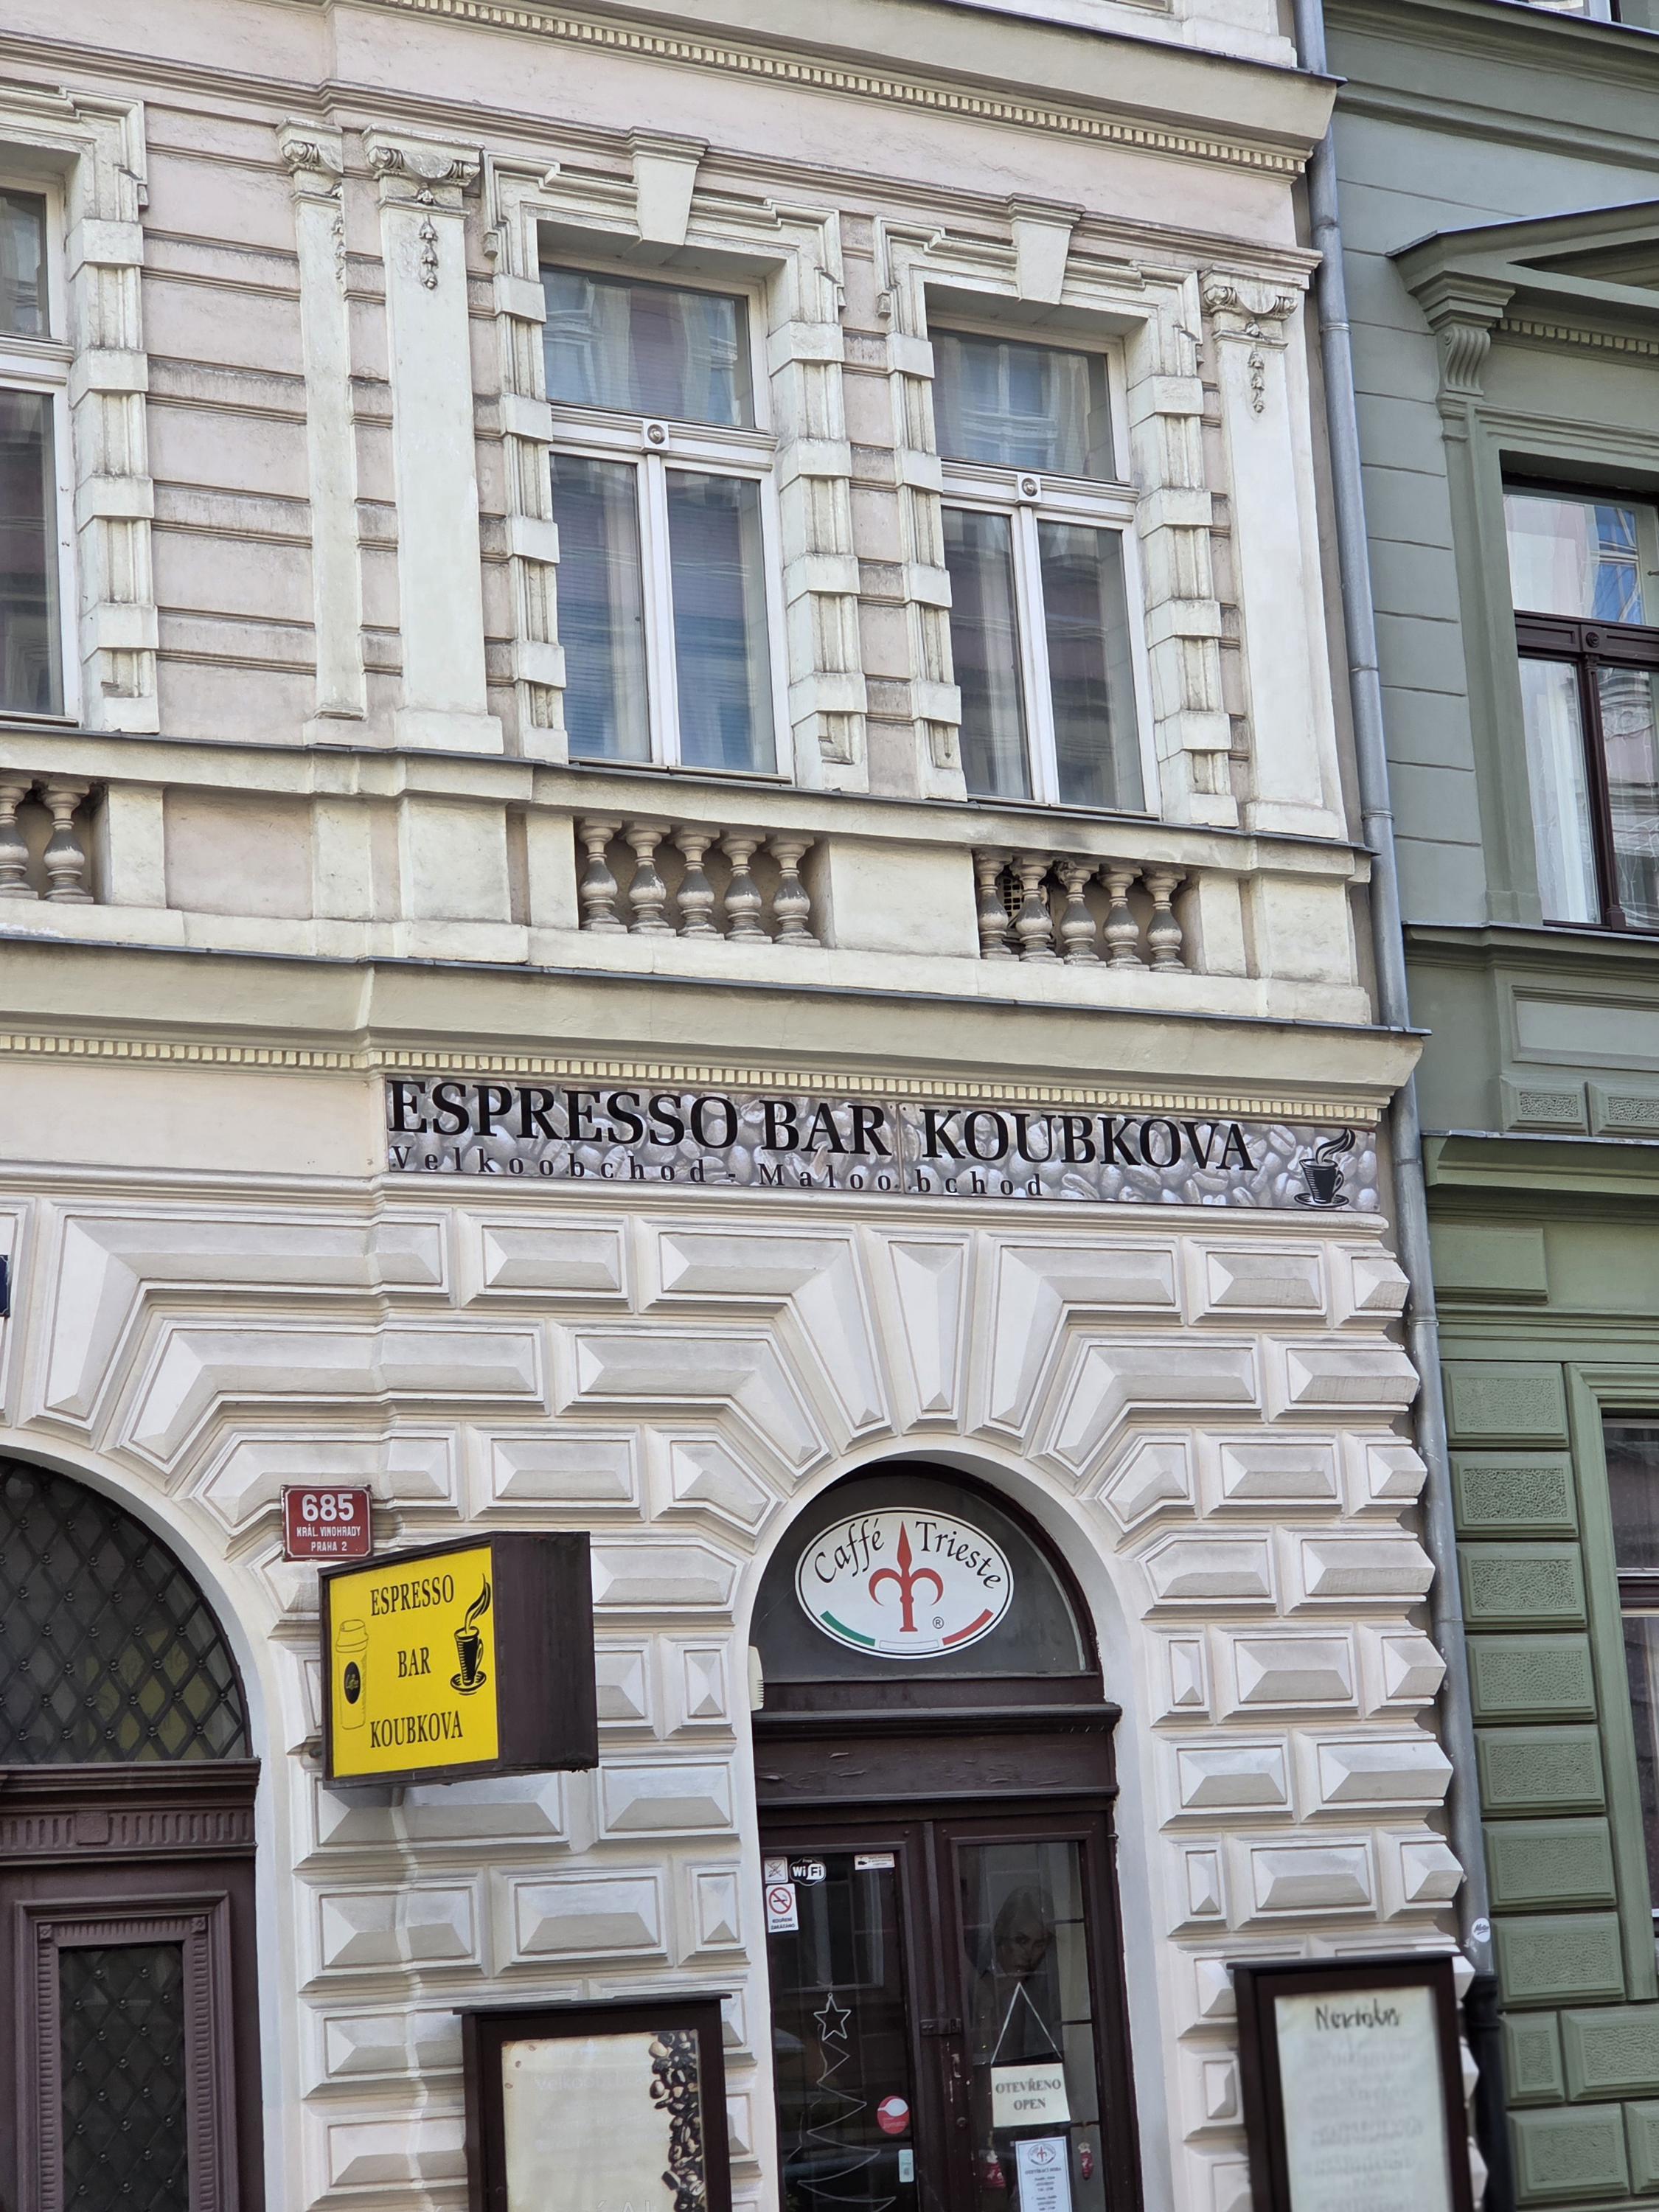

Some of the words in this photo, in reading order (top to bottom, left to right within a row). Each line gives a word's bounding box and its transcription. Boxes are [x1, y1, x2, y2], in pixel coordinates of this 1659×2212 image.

[386, 1079, 737, 1149] ESPRESSO
[759, 1099, 891, 1156] BAR
[919, 1108, 1258, 1172] KOUBKOVA
[391, 1145, 706, 1183] Velkoobchod
[757, 1163, 1043, 1196] Maloobchod
[302, 1494, 354, 1521] 685
[310, 1541, 338, 1552] PRAHA
[341, 1541, 347, 1551] 2
[320, 1526, 361, 1537] VINOHRADY
[814, 1517, 885, 1584] Caffé
[915, 1520, 1001, 1589] Trieste
[370, 1574, 454, 1616] ESPRESSO
[397, 1647, 431, 1678] BAR
[369, 1710, 463, 1748] KOUBKOVA
[995, 2078, 1062, 2094] OTEVŘENO
[1013, 2098, 1046, 2111] OPEN
